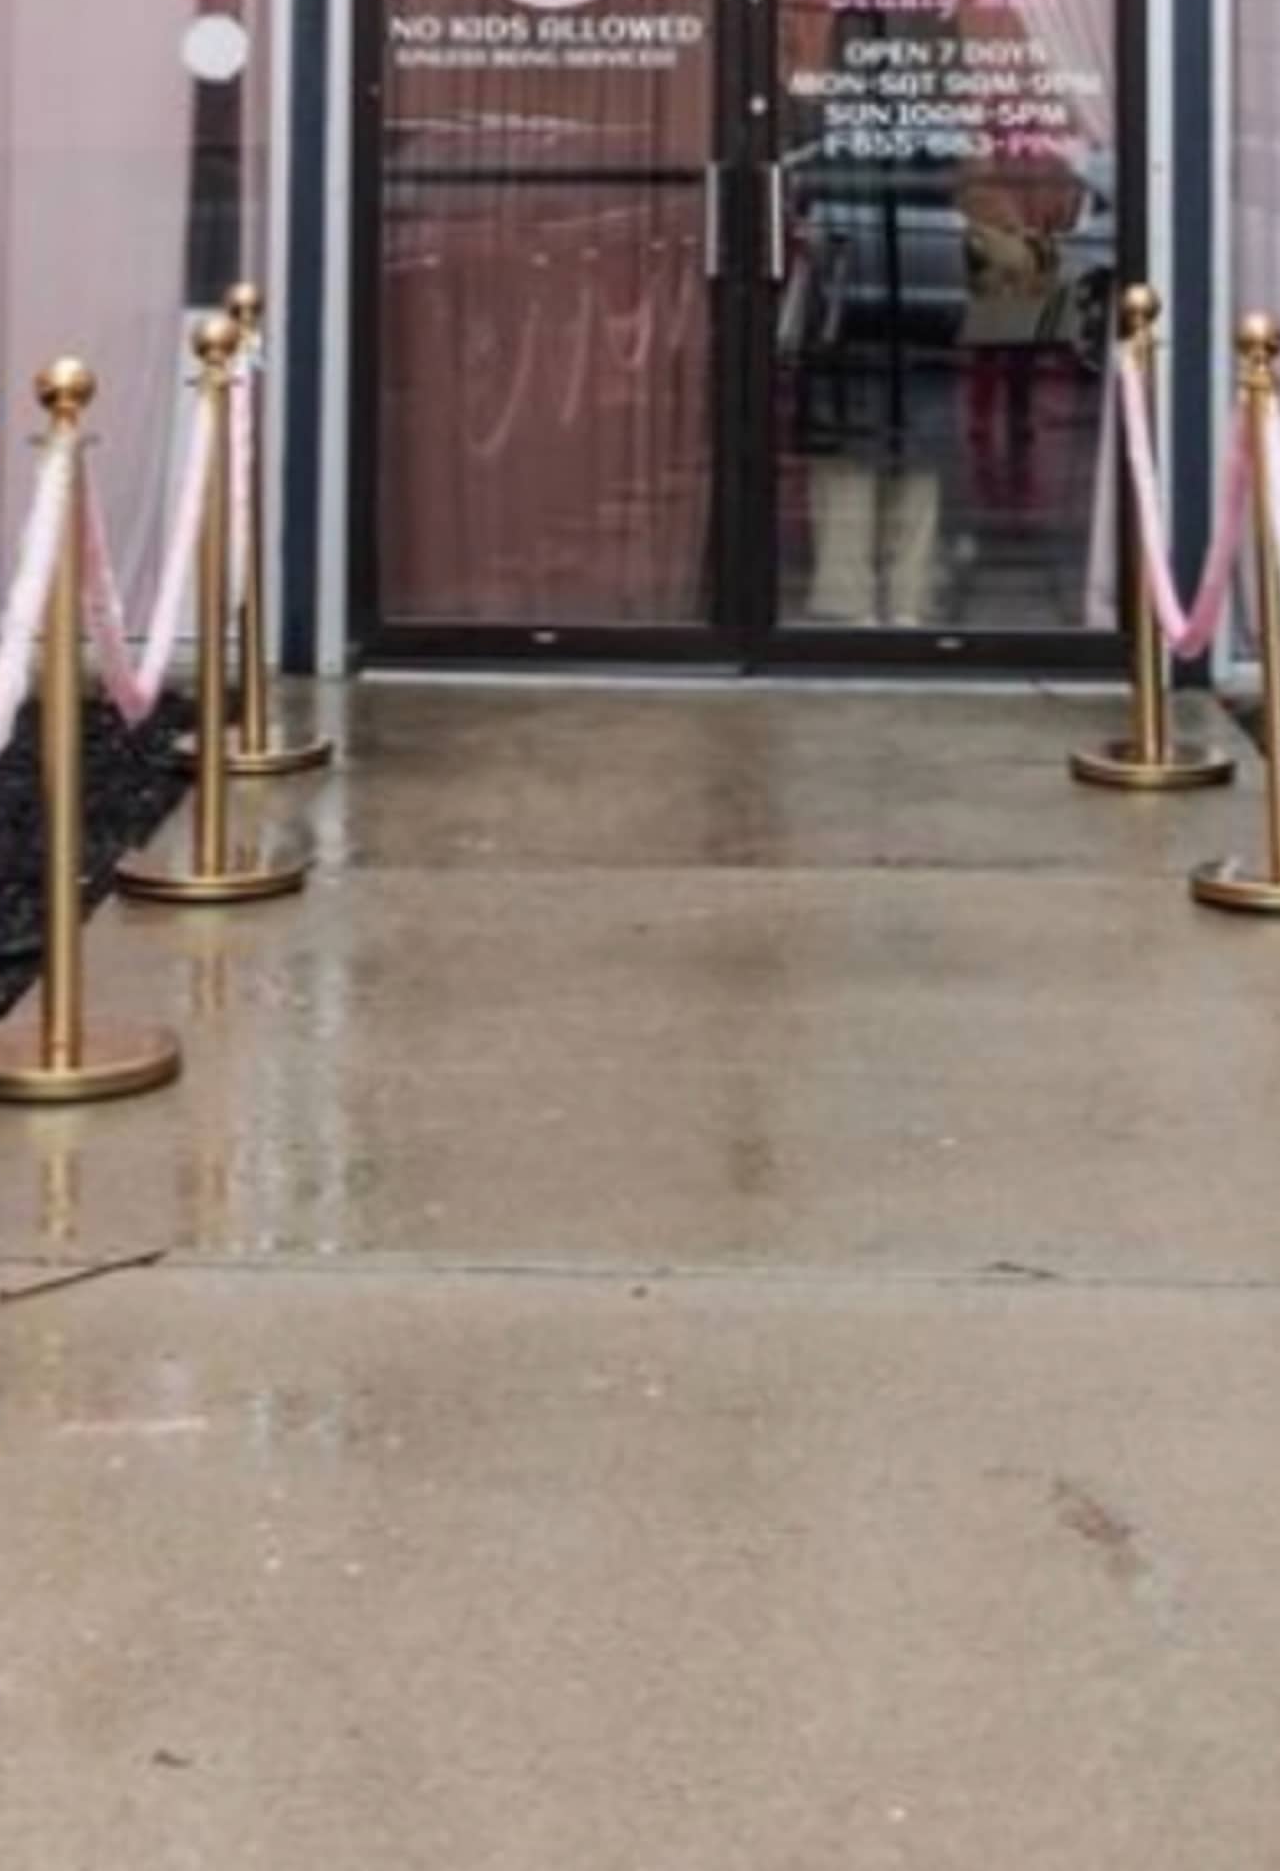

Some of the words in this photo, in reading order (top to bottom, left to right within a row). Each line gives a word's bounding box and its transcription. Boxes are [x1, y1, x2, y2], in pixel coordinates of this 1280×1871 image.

[389, 15, 441, 43] NO
[449, 15, 528, 43] KIDS
[537, 15, 704, 44] ALLOWED
[843, 39, 929, 65] OPEN
[938, 40, 956, 64] 7
[963, 39, 1046, 65] DAYS
[824, 102, 892, 125] SUN
